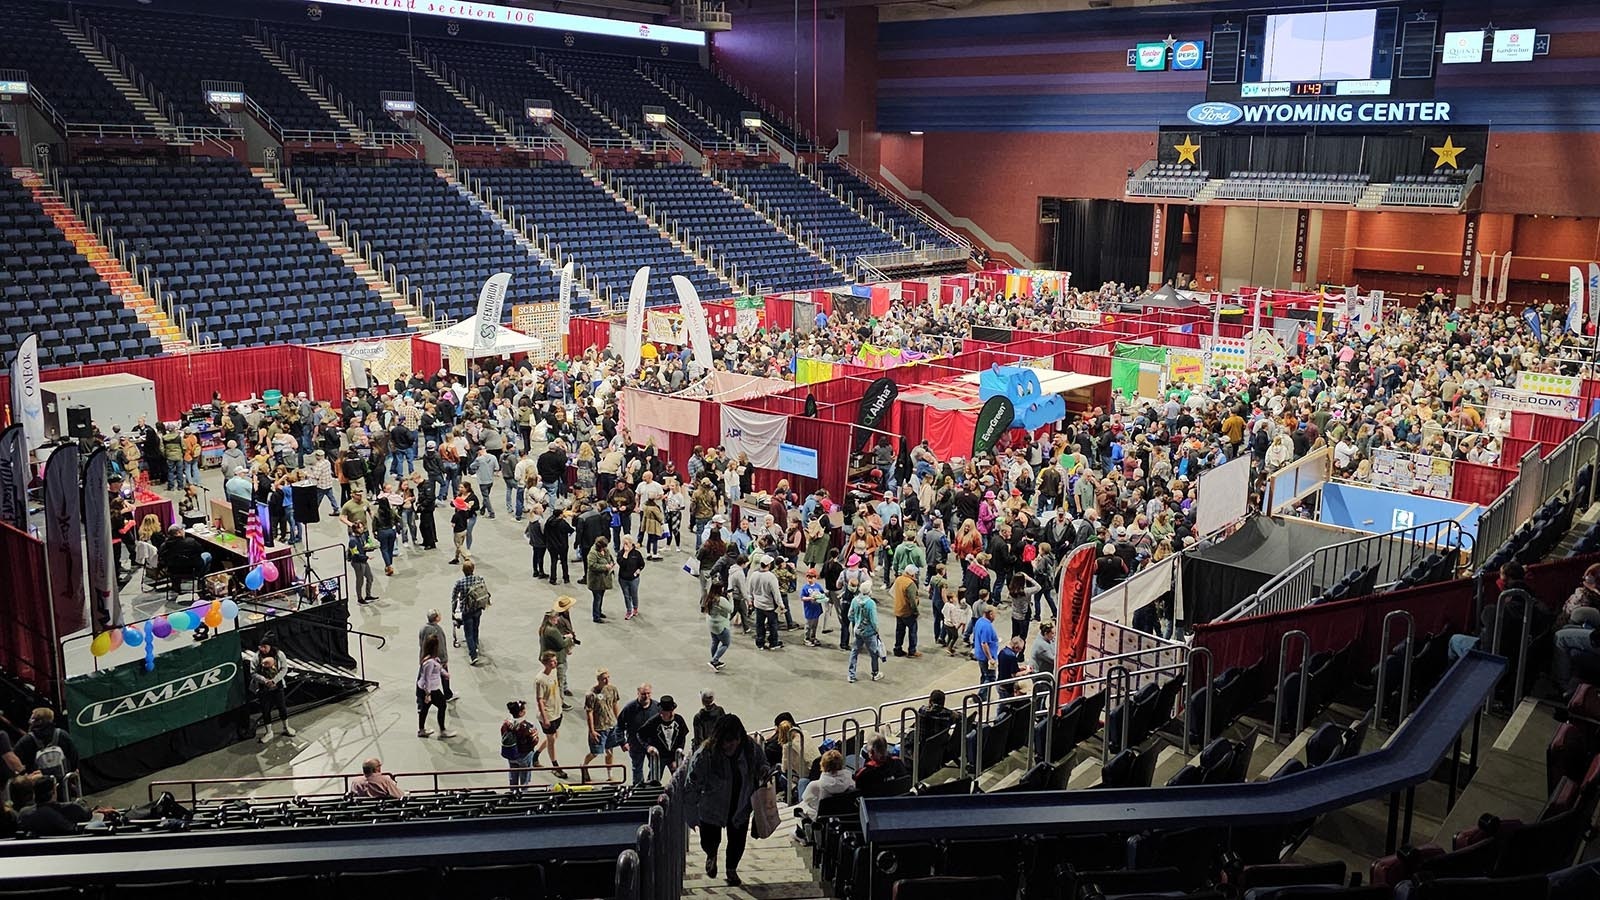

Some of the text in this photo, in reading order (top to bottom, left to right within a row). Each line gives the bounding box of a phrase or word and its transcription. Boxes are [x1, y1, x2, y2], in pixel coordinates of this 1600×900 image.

[306, 8, 322, 17] 204
[428, 3, 496, 18] section
[507, 11, 536, 23] 106
[447, 23, 460, 32] 203
[1199, 106, 1231, 121] Ford
[1243, 102, 1450, 122] WYOMING CENTER
[37, 146, 49, 154] 106
[1152, 241, 1160, 256] WYO
[1462, 222, 1475, 277] CASPER WYO
[482, 282, 498, 322] CENTURION
[517, 303, 561, 315] SCRABBLE
[25, 352, 34, 397] ONEOK
[870, 388, 891, 416] Alpha
[1493, 391, 1562, 407] FREEDOM
[981, 404, 1006, 441] EverGreen
[1072, 573, 1083, 624] CHOICE
[92, 668, 221, 721] LAMAR
